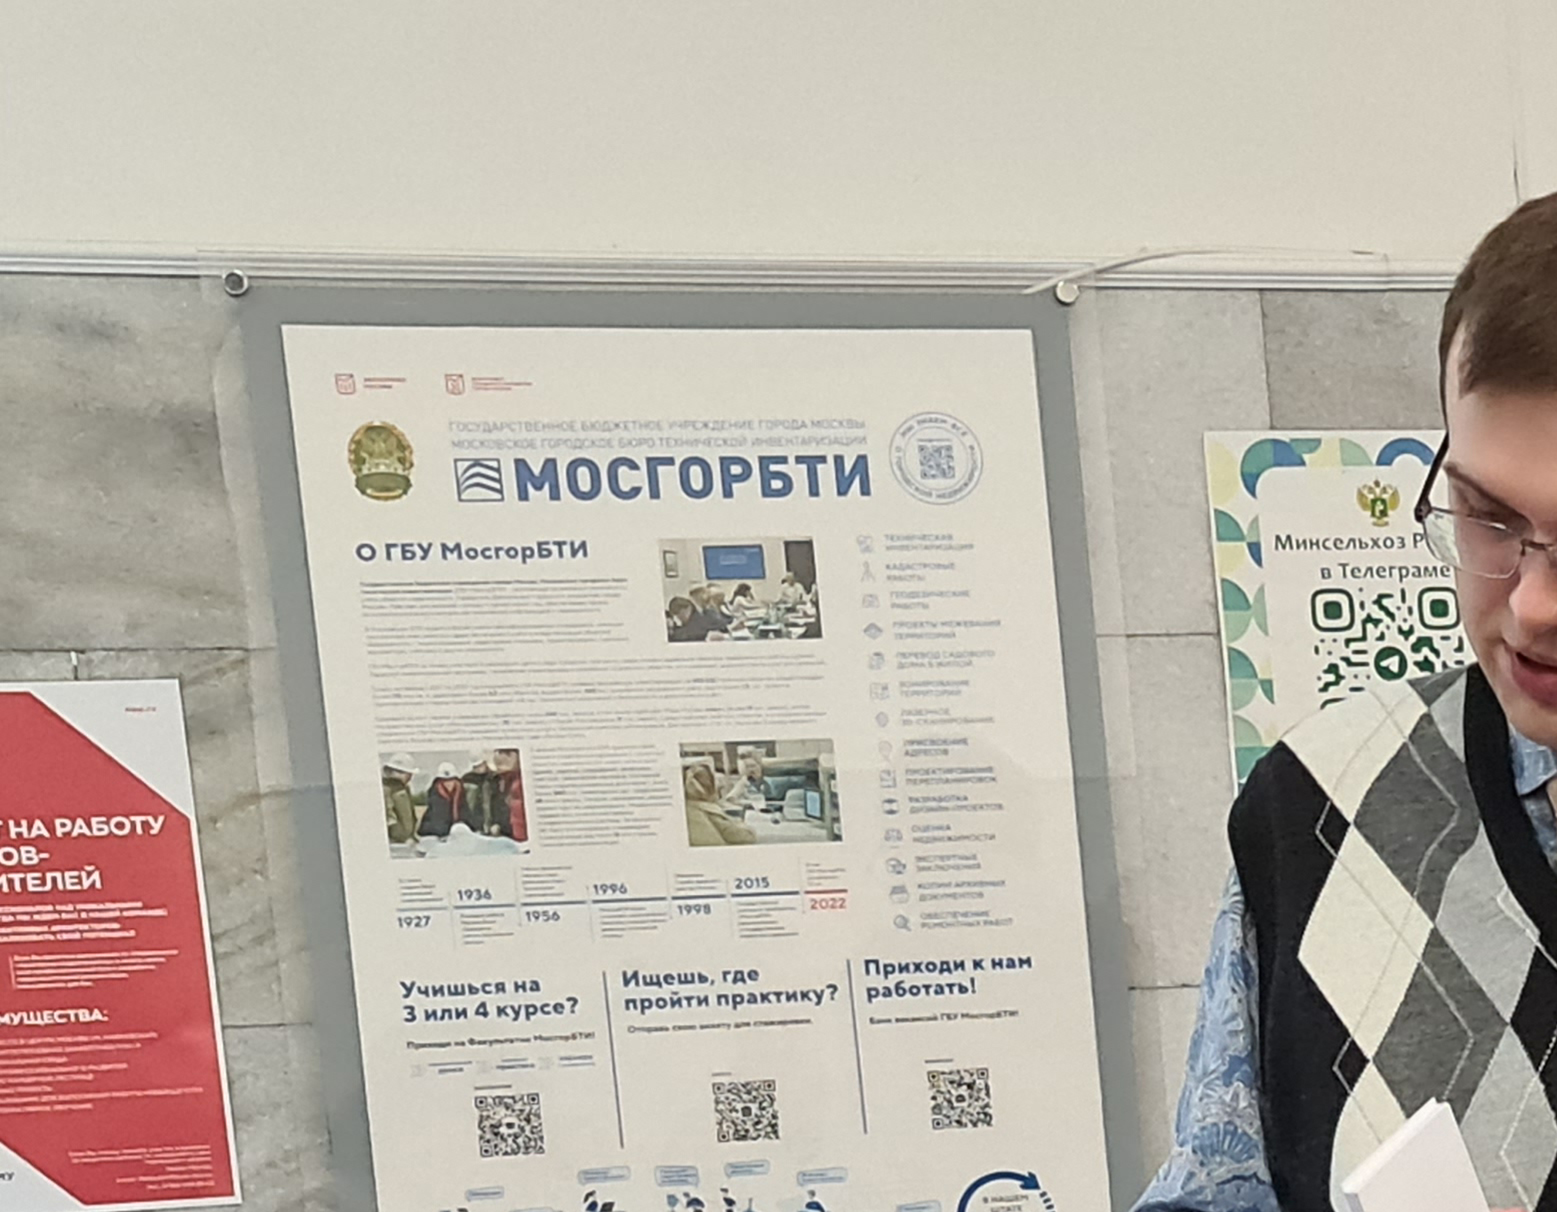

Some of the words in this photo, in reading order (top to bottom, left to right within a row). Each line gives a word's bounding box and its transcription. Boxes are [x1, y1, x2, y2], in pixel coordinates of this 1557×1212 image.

[758, 419, 807, 430] ГОРОДА
[811, 418, 866, 429] МОСКВЫ
[513, 453, 872, 502] МОСГОРБТИ
[355, 543, 377, 562] О
[385, 542, 433, 562] ГБУ
[441, 540, 589, 564] МосгорБТИ
[1274, 533, 1407, 551] Минсельхоз
[1320, 566, 1332, 580] в
[1338, 561, 1451, 584] Телеграме
[8, 818, 50, 839] НА
[54, 815, 165, 838] РАБОТУ
[594, 883, 629, 896] 1996
[734, 876, 771, 890] 2015
[457, 889, 493, 901] 1936
[810, 898, 848, 911] 2022
[526, 911, 561, 923] 1956
[677, 903, 712, 916] 1998
[398, 915, 432, 929] 1927
[622, 970, 715, 988] Ищешь,
[722, 968, 760, 985] где
[864, 958, 966, 980] Приходи
[972, 958, 985, 971] к
[991, 956, 1033, 971] нам
[400, 980, 506, 999] Учишься
[514, 979, 542, 993] на
[625, 991, 709, 1015] пройти
[716, 983, 839, 1010] практику?
[866, 976, 977, 1004] работать!
[403, 1005, 417, 1022] 3
[424, 1006, 469, 1022] или
[474, 1001, 489, 1019] 4
[496, 996, 580, 1022] курсе?
